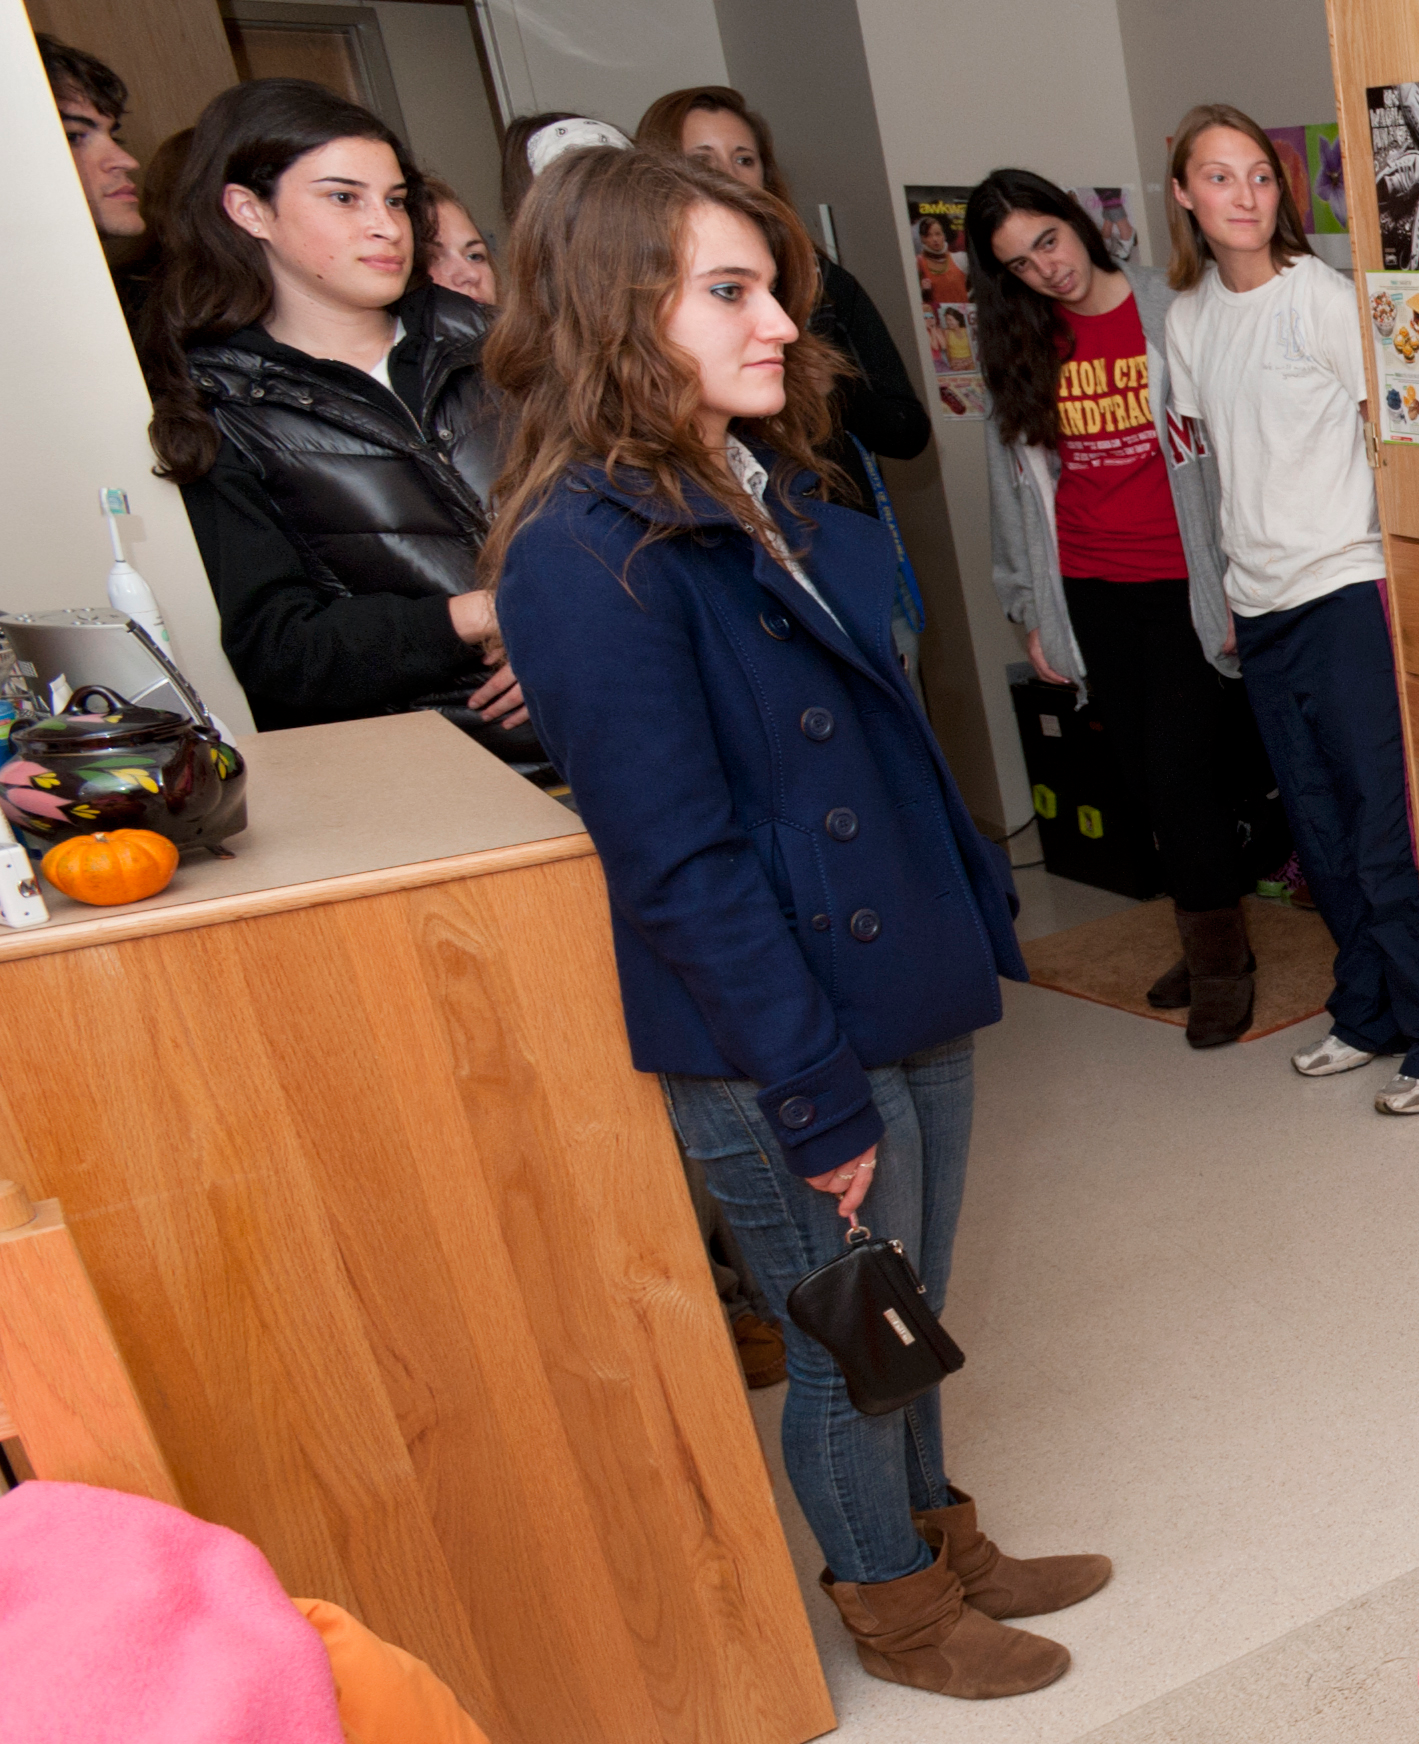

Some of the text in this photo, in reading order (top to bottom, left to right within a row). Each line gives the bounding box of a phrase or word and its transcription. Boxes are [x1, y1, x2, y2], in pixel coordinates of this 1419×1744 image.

[919, 200, 967, 214] awkwa
[1058, 355, 1148, 397] TION CIT
[1166, 405, 1211, 470] M
